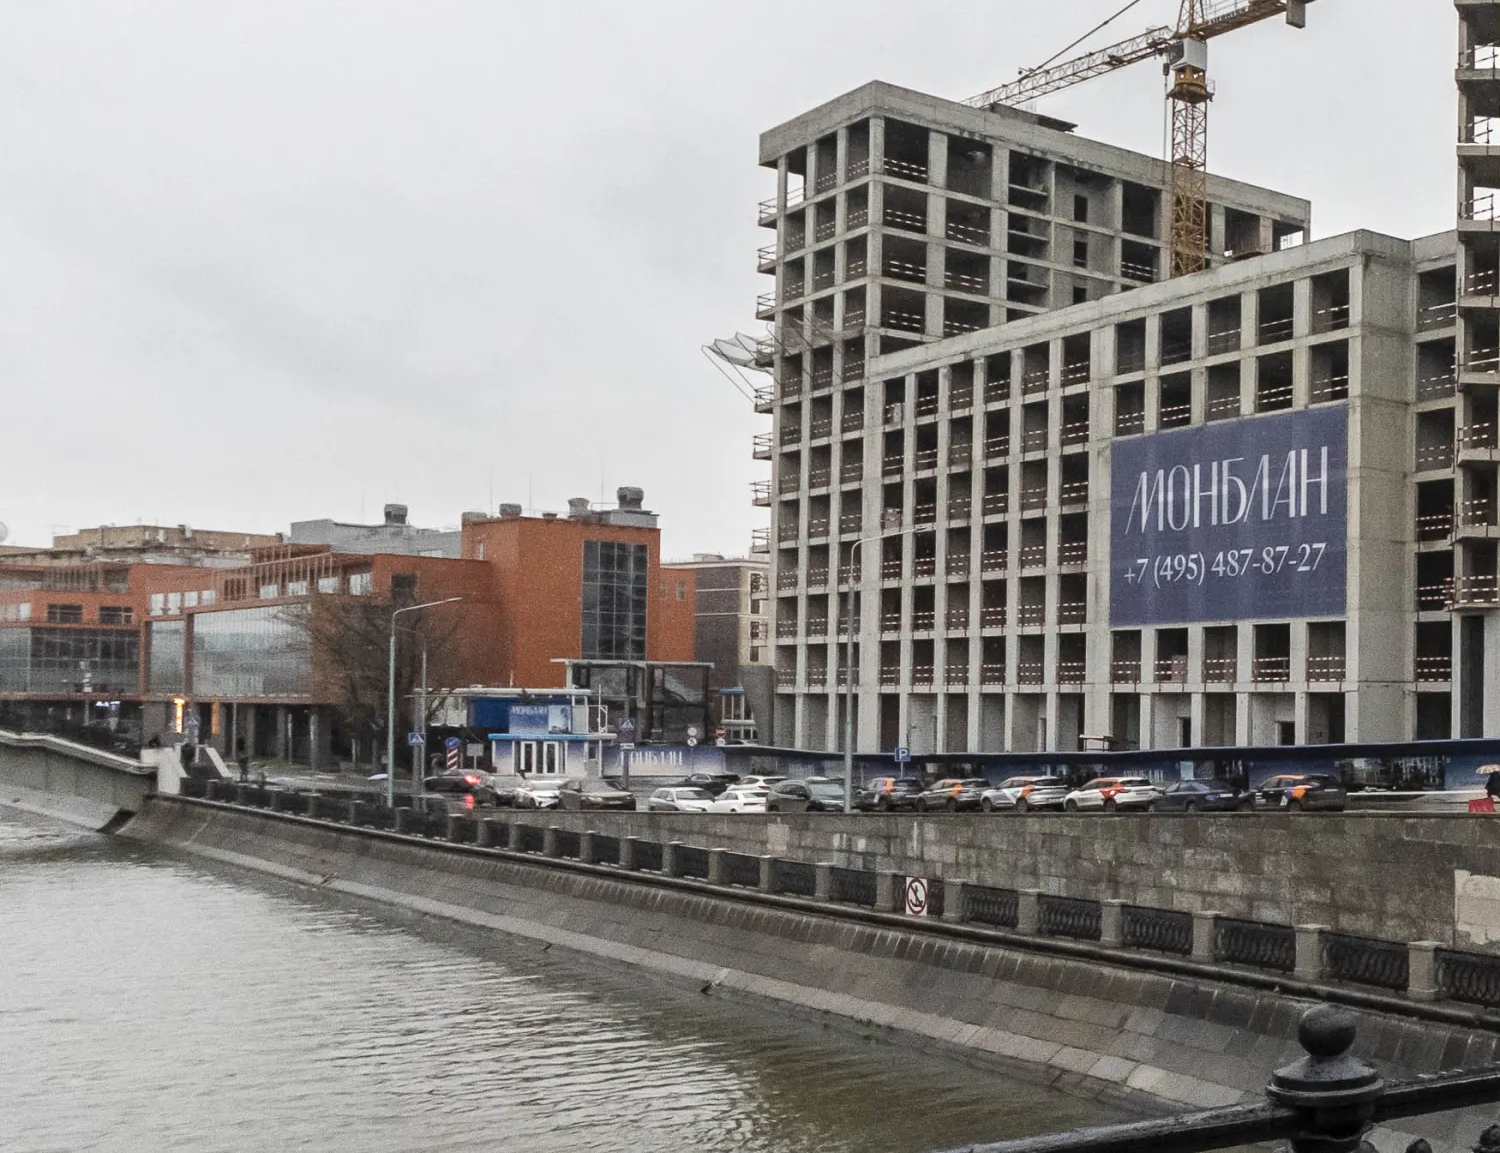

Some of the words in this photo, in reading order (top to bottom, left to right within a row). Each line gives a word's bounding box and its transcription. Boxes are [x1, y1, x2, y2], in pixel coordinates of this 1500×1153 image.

[1125, 446, 1328, 535] МОНБЛАН
[1124, 558, 1148, 584] +7
[1154, 551, 1206, 588] (495)
[1211, 542, 1327, 577] 487-87-27
